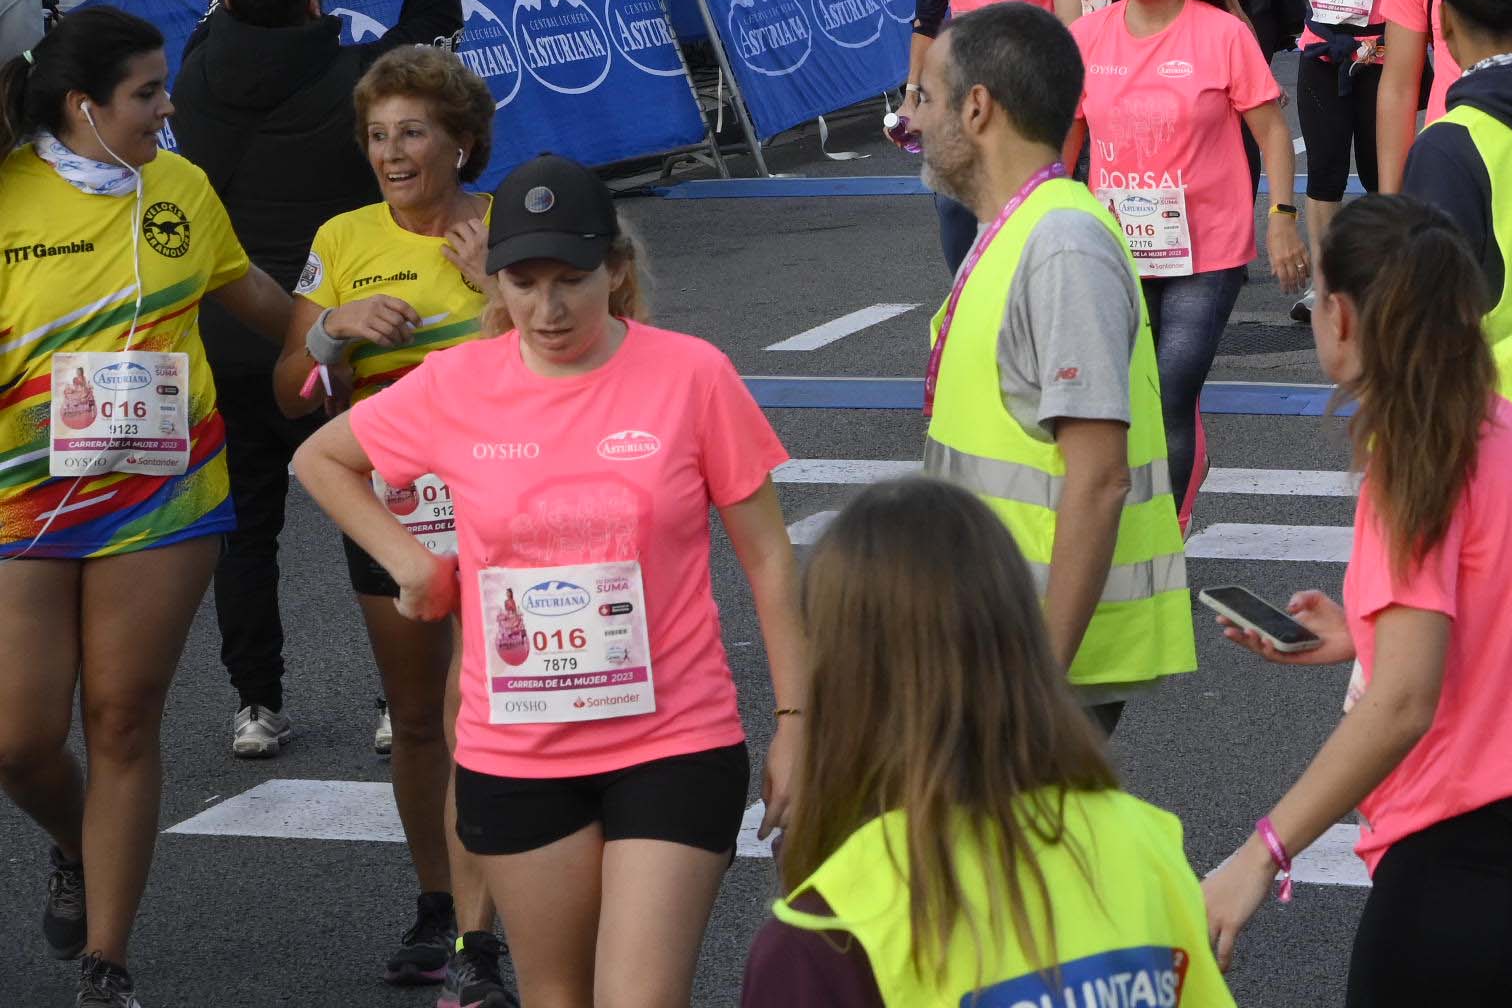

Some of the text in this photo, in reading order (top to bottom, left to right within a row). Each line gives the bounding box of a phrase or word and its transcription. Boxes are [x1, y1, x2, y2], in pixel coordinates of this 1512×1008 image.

[624, 3, 656, 15] CENTRAL
[529, 12, 589, 29] CENTRAL LECHERA
[521, 23, 606, 68] ASTURIANA
[1090, 64, 1128, 76] OYSHO
[1100, 168, 1188, 190] DORSAL
[1125, 224, 1155, 236] 016
[97, 370, 148, 384] ASTURIANA
[155, 369, 178, 377] SUMA
[101, 401, 147, 418] 016
[109, 423, 138, 435] 9123
[69, 440, 177, 449] CARRERA DE LA MUJER 2023
[472, 443, 539, 459] OYSHO
[602, 441, 659, 455] ASTURIANA
[64, 457, 107, 467] OYSHO
[137, 456, 179, 467] Santander
[422, 484, 451, 501] 01
[433, 505, 454, 517] 912
[596, 581, 629, 594] SUMA
[525, 593, 586, 609] ASTURIANA
[533, 628, 587, 651] 016
[543, 658, 577, 672] 7879
[507, 671, 634, 689] CARRERA DE LA MUJER 2023
[505, 700, 547, 713] OYSHO
[586, 693, 640, 708] Santander
